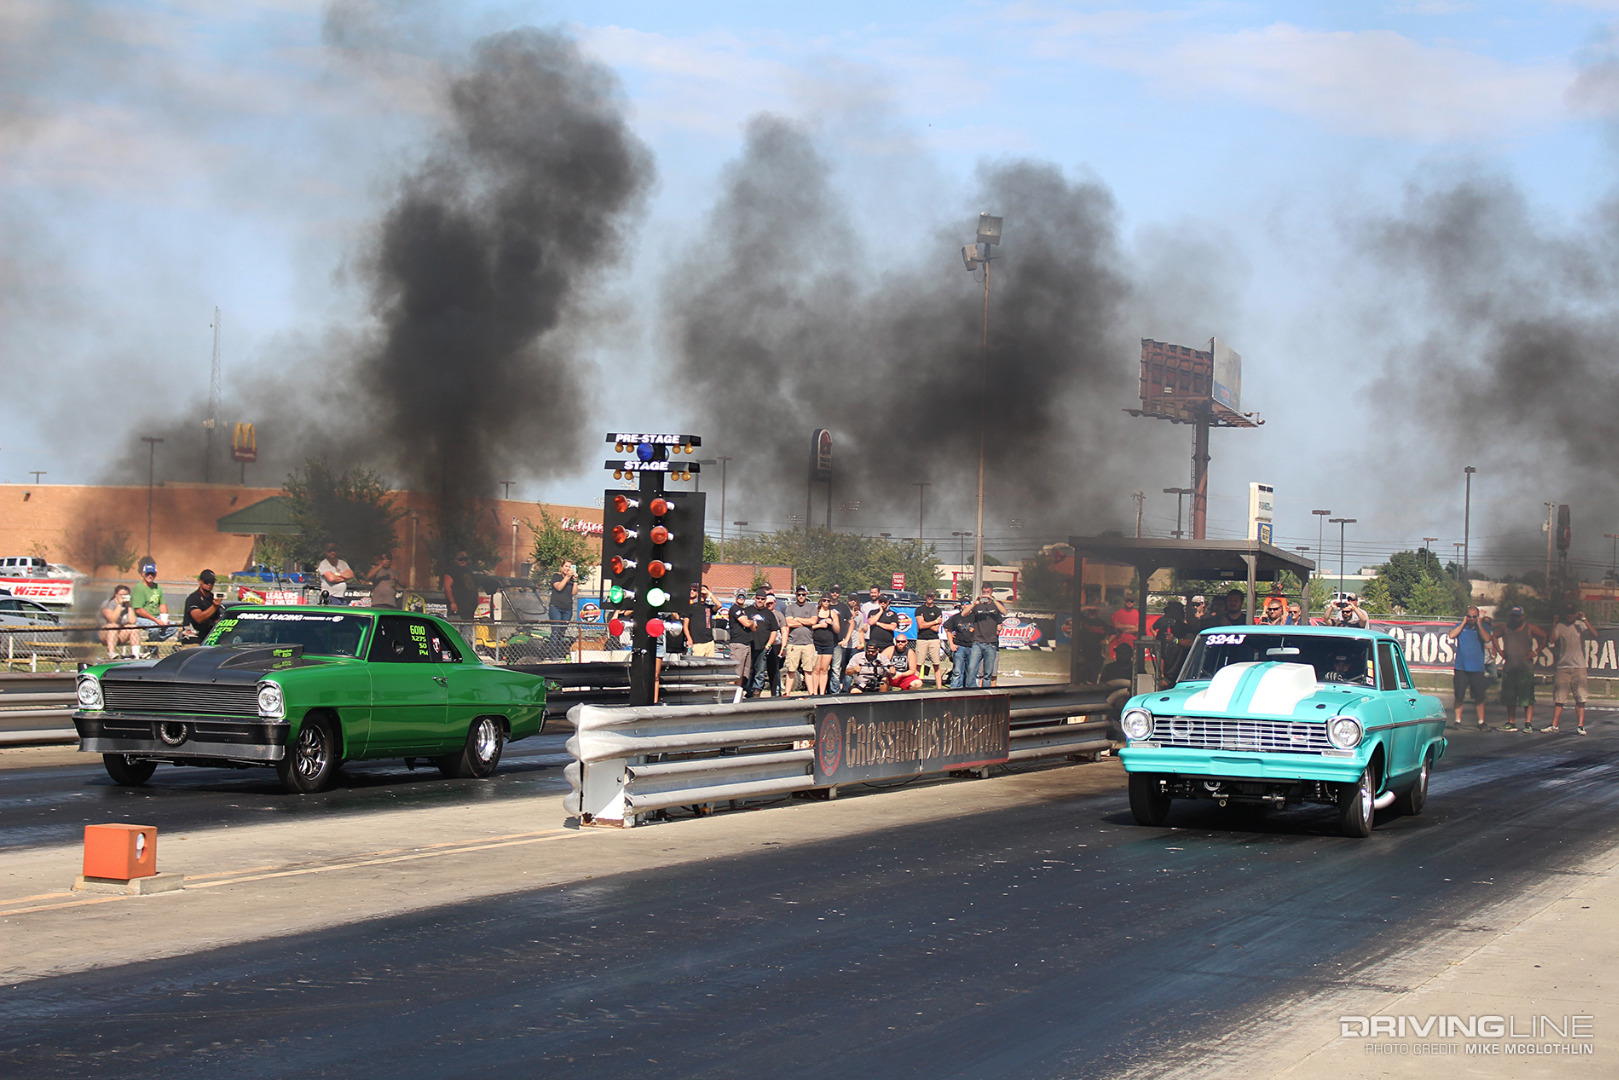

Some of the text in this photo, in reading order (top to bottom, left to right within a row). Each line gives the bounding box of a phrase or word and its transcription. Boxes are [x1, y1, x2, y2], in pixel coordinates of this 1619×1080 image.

[615, 434, 680, 444] PRE-STAGE
[624, 461, 669, 470] STAGE
[410, 624, 425, 635] 6010
[999, 626, 1032, 638] UMMIT
[1205, 634, 1246, 645] 324J
